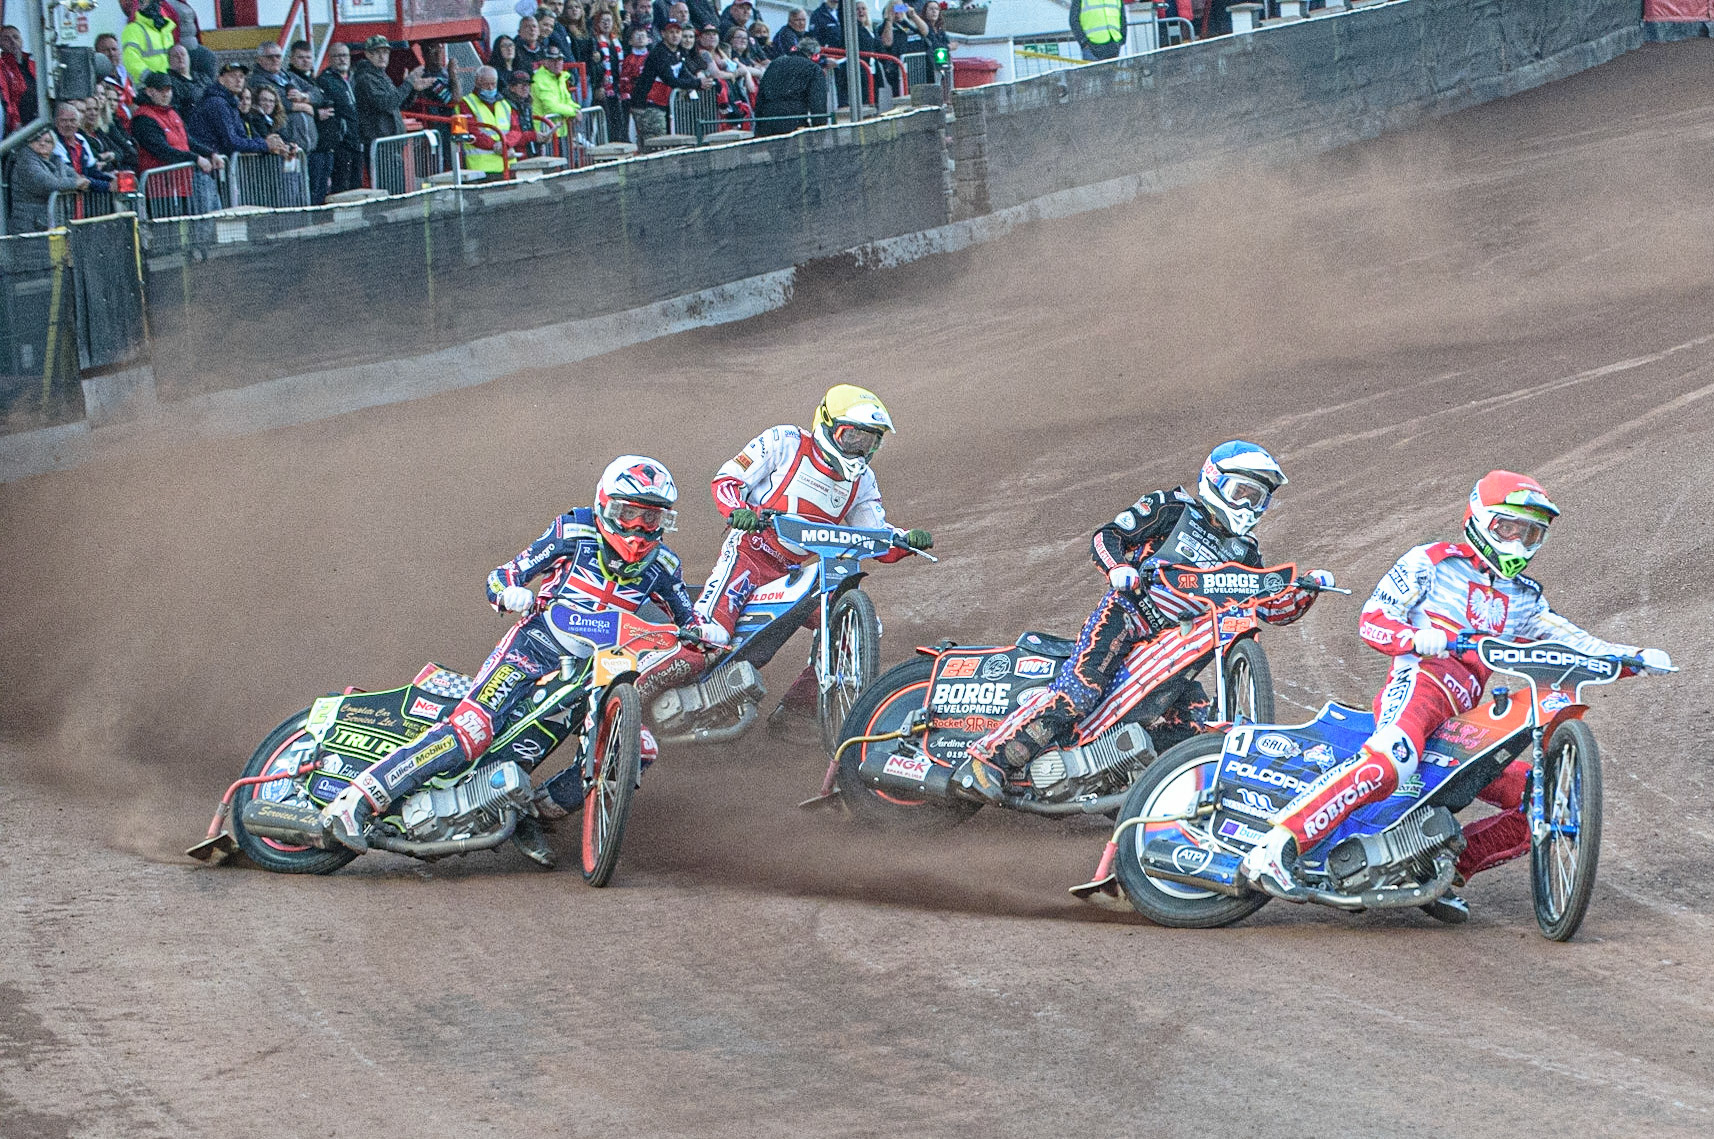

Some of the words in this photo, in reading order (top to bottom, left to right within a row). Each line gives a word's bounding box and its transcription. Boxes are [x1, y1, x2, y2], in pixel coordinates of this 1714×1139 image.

[801, 529, 875, 550] MOLDOW
[1203, 573, 1259, 589] BORGE
[750, 592, 784, 601] OLDOW
[1222, 618, 1251, 632] 22
[945, 658, 981, 678] 22
[1019, 660, 1050, 674] 100%
[1490, 650, 1612, 676] POLCOPPER
[481, 666, 514, 703] POWER
[489, 671, 522, 710] MAXED
[932, 683, 1012, 704] BORGE
[312, 701, 334, 725] 2
[414, 700, 439, 713] NGK
[377, 717, 397, 728] Ltd
[455, 710, 488, 744] STAR
[933, 718, 963, 729] Rocket
[930, 736, 966, 749] Jardine
[1234, 732, 1246, 751] 1
[390, 760, 415, 783] Allied
[415, 738, 453, 766] Mobility
[889, 757, 928, 772] NGK
[1225, 760, 1309, 794] POLCOPP
[1179, 850, 1206, 863] ATPI
